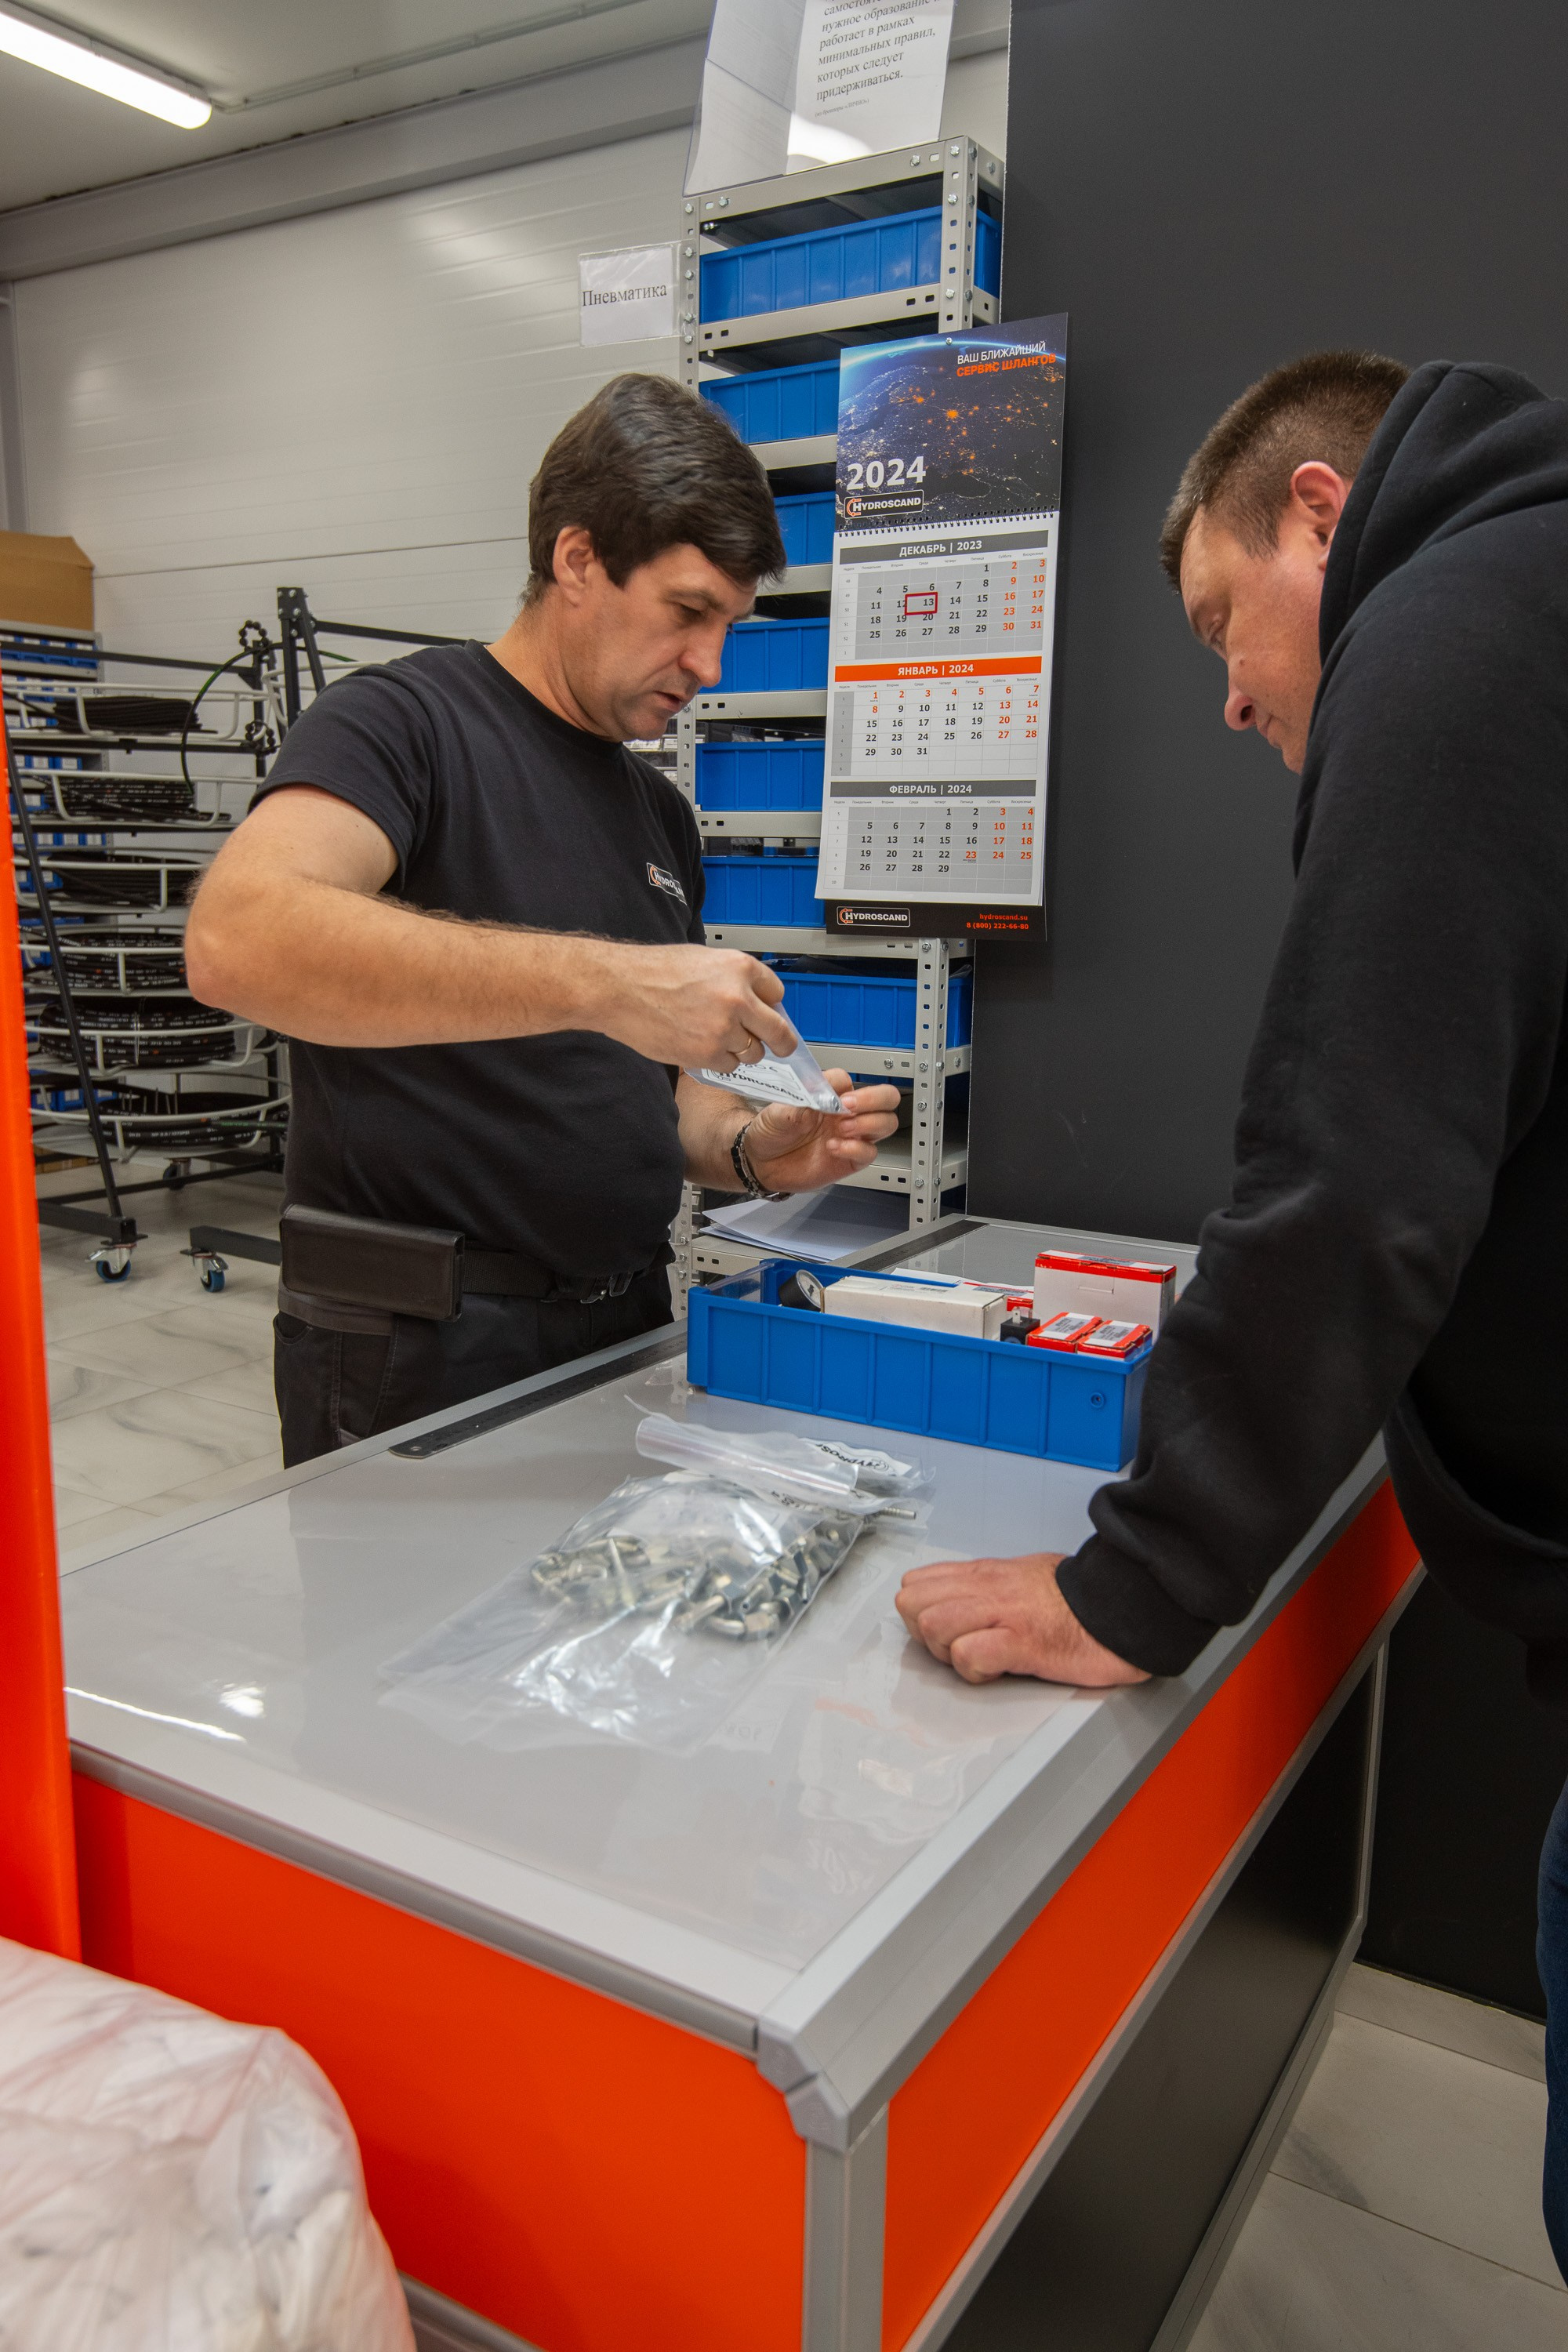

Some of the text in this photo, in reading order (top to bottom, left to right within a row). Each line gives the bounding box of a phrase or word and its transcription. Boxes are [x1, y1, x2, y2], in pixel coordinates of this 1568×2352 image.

[824, 0, 880, 16] самостоя
[819, 28, 866, 51] работает
[877, 16, 915, 36] рамках
[822, 15, 862, 34] нужное
[818, 27, 936, 65] минимальных правил,
[817, 51, 904, 83] которых следует
[816, 71, 904, 102] придерживаться.
[583, 285, 667, 307] Пневматика
[957, 341, 1047, 365] ВАШ БЛИЖАЙШИЙ
[956, 353, 1057, 378] СЕРВИС ШЛАНГОВ
[846, 456, 927, 491] 2024
[853, 497, 921, 512] HYDROSCAND
[899, 541, 982, 557] ДЕКАБРЬ 2023
[1033, 590, 1044, 598] 17
[898, 664, 974, 676] ЯНВАРЬ 2024
[889, 784, 972, 794] ФЕВРАЛЬ 2024
[845, 912, 908, 921] HYDROSCAND
[719, 1070, 804, 1102] HYDROSCAND
